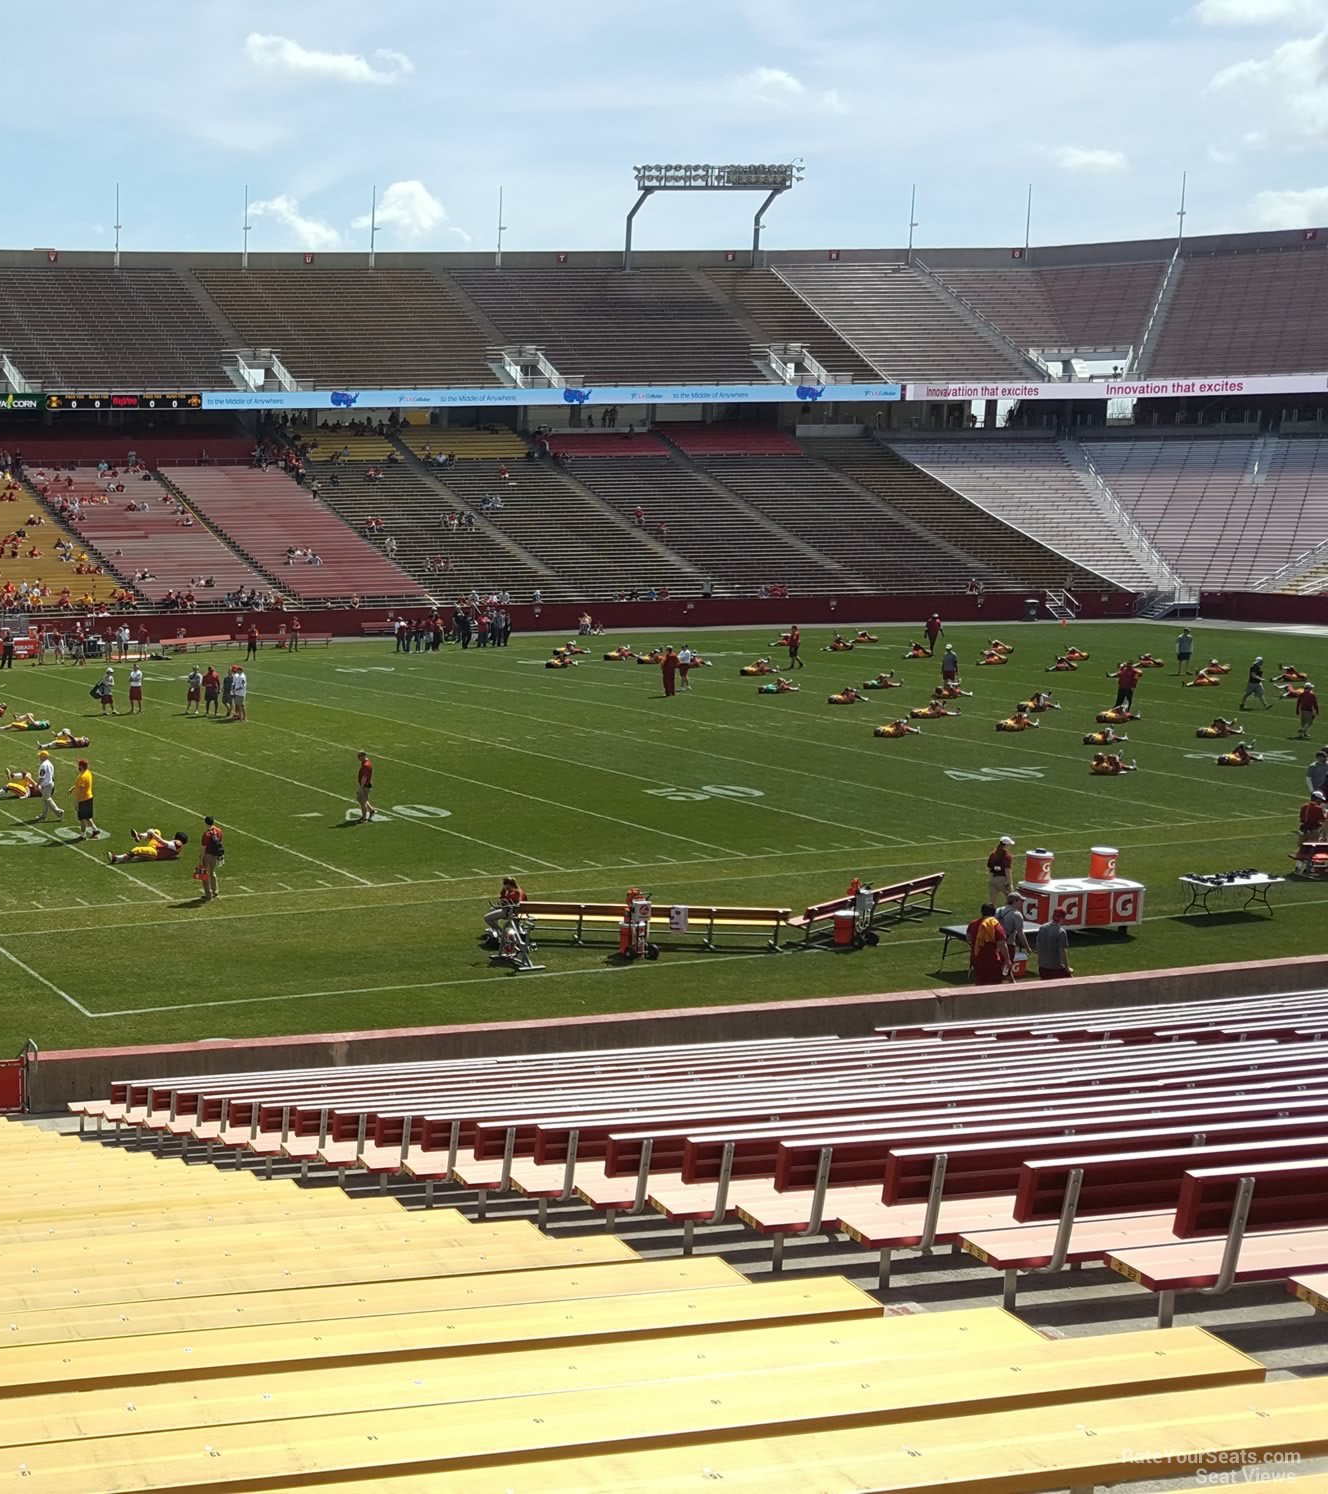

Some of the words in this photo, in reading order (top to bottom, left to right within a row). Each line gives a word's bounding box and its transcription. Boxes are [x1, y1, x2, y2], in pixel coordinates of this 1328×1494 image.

[981, 386, 999, 397] that
[1106, 383, 1168, 395] Innovation
[1172, 382, 1195, 393] that
[1199, 381, 1244, 392] excites
[641, 785, 765, 801] 50
[1042, 862, 1051, 873] G
[1108, 858, 1116, 869] G
[1023, 898, 1038, 921] G
[1061, 897, 1079, 920] G
[1116, 893, 1134, 917] G
[1012, 962, 1020, 973] G
